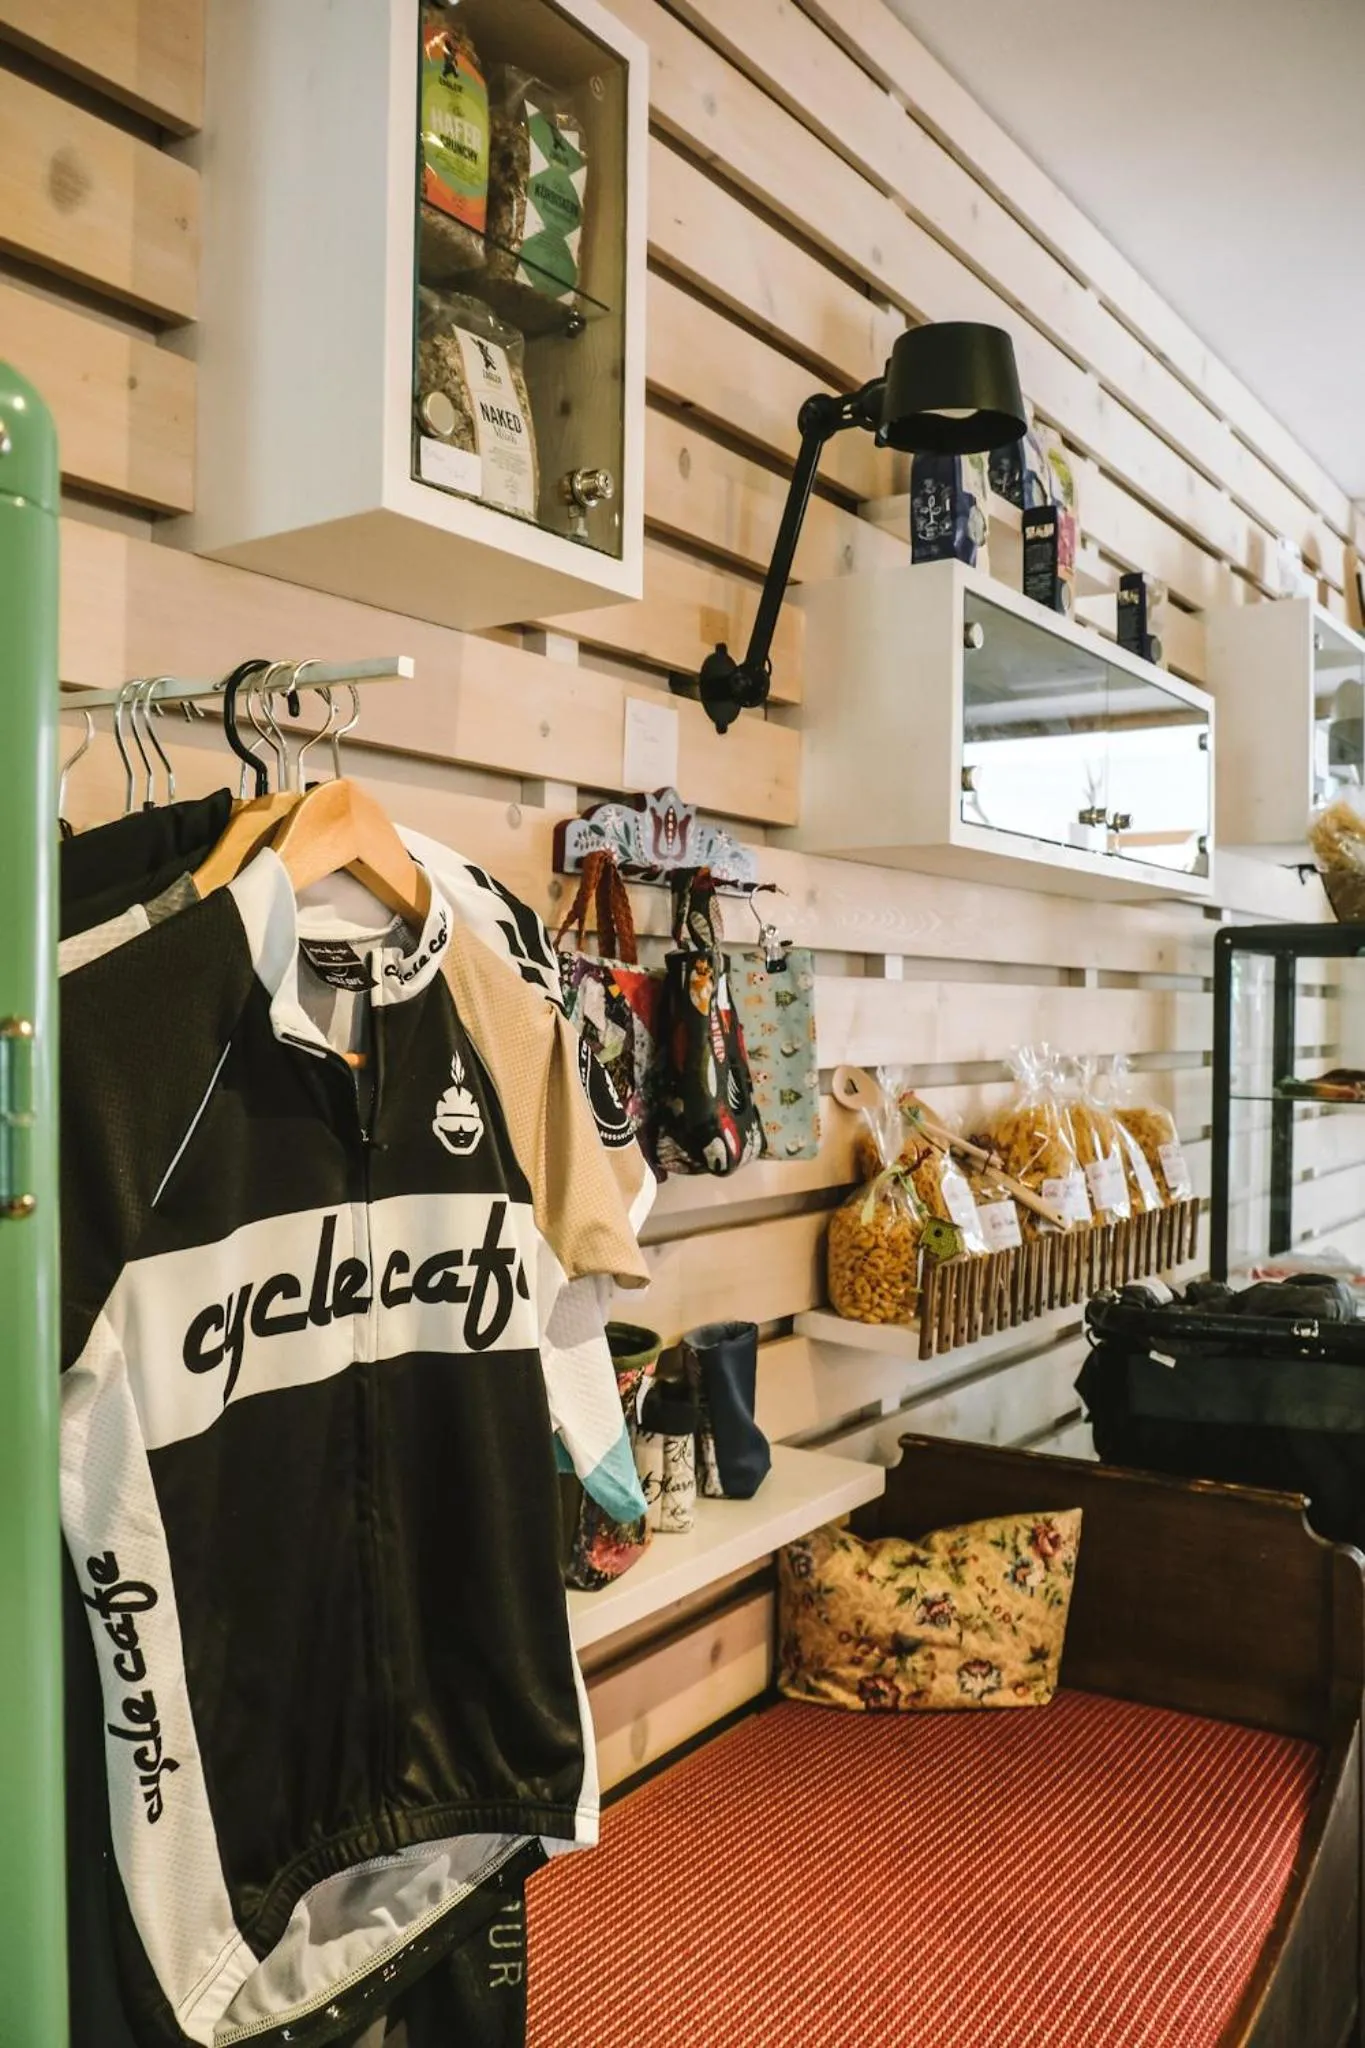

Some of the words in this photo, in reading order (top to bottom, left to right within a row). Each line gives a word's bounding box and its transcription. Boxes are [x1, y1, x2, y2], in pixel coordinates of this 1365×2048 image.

[428, 105, 482, 153] HAFER
[440, 133, 478, 165] CRUNCHY
[480, 401, 522, 434] NAKED
[429, 909, 448, 954] ca
[83, 1550, 158, 1682] cafe
[107, 1690, 181, 1825] cycle
